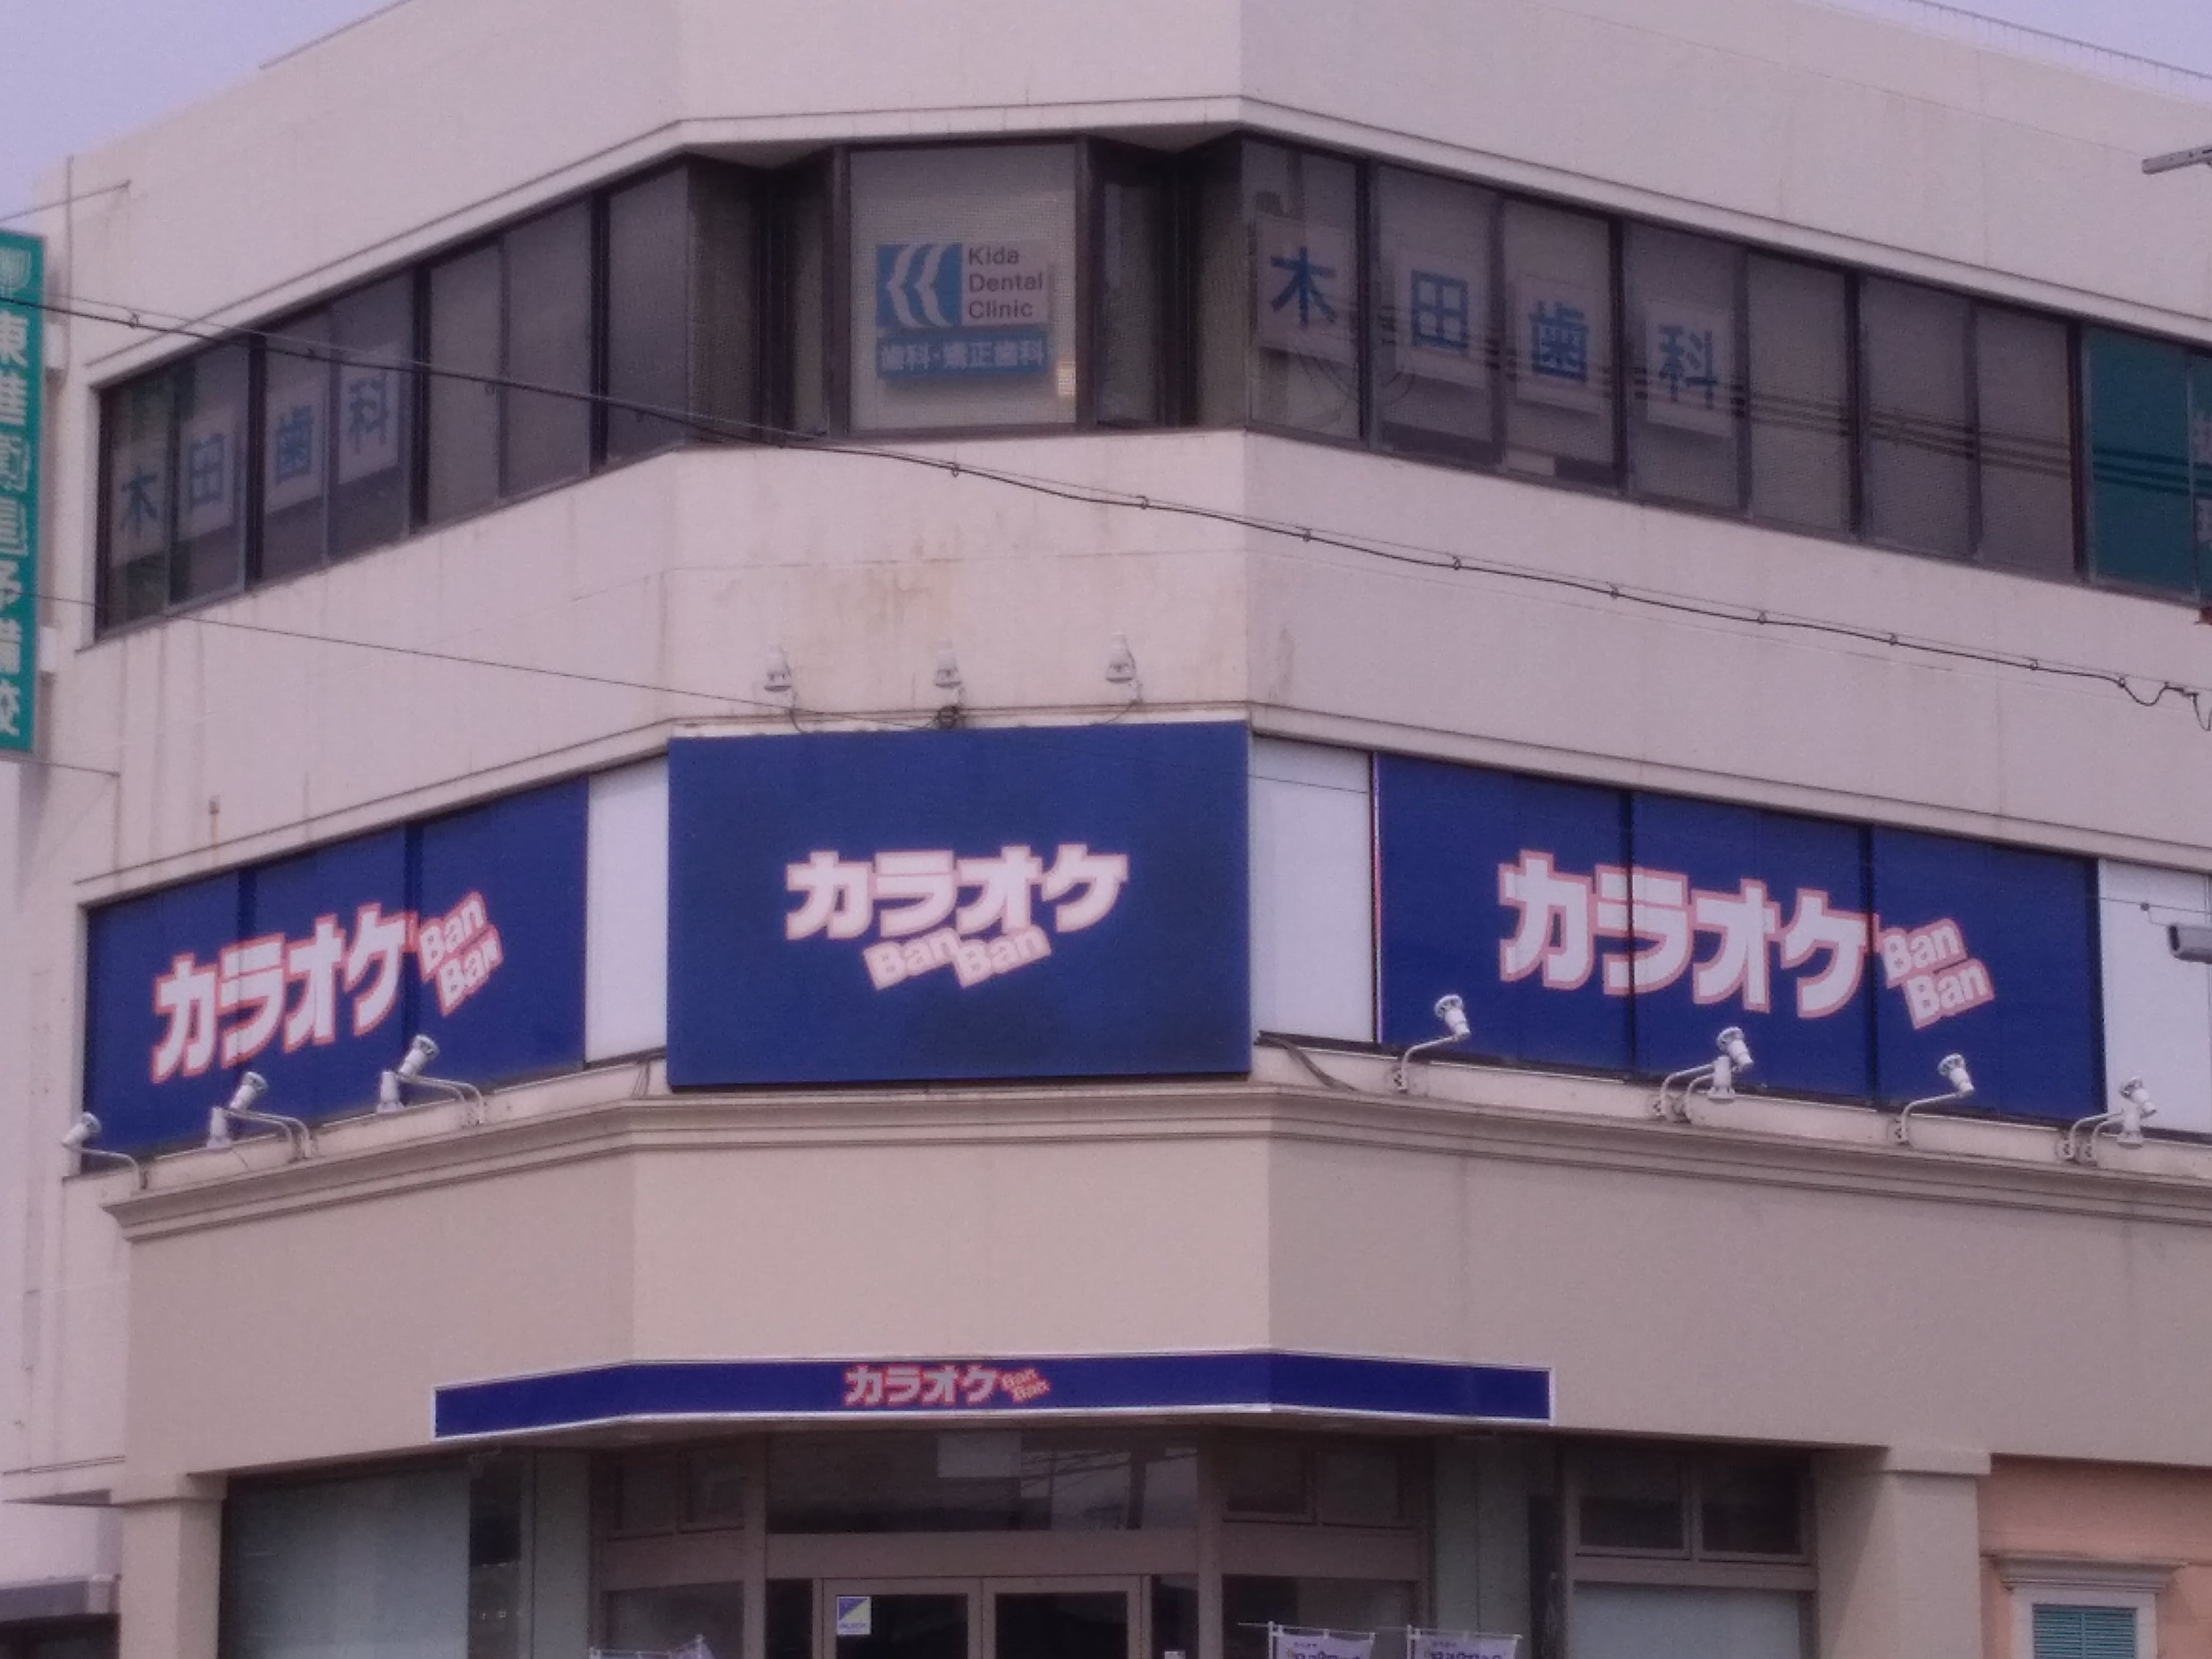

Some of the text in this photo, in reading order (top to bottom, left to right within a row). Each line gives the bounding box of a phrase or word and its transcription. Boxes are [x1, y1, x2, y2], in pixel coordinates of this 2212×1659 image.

[968, 247, 1020, 265] Kida
[968, 272, 1044, 292] Dental
[968, 299, 1033, 319] Clinic
[1270, 246, 1719, 410] 木田歯科
[785, 843, 1128, 940] カラオケ
[418, 890, 488, 982] Ban
[434, 923, 503, 1016] Ban
[1498, 849, 1876, 1019] カラオケ
[1879, 918, 1967, 988] Ban
[152, 903, 415, 1083] カラオケ
[1904, 958, 1995, 1030] Ban
[845, 1363, 998, 1406] カラオケ
